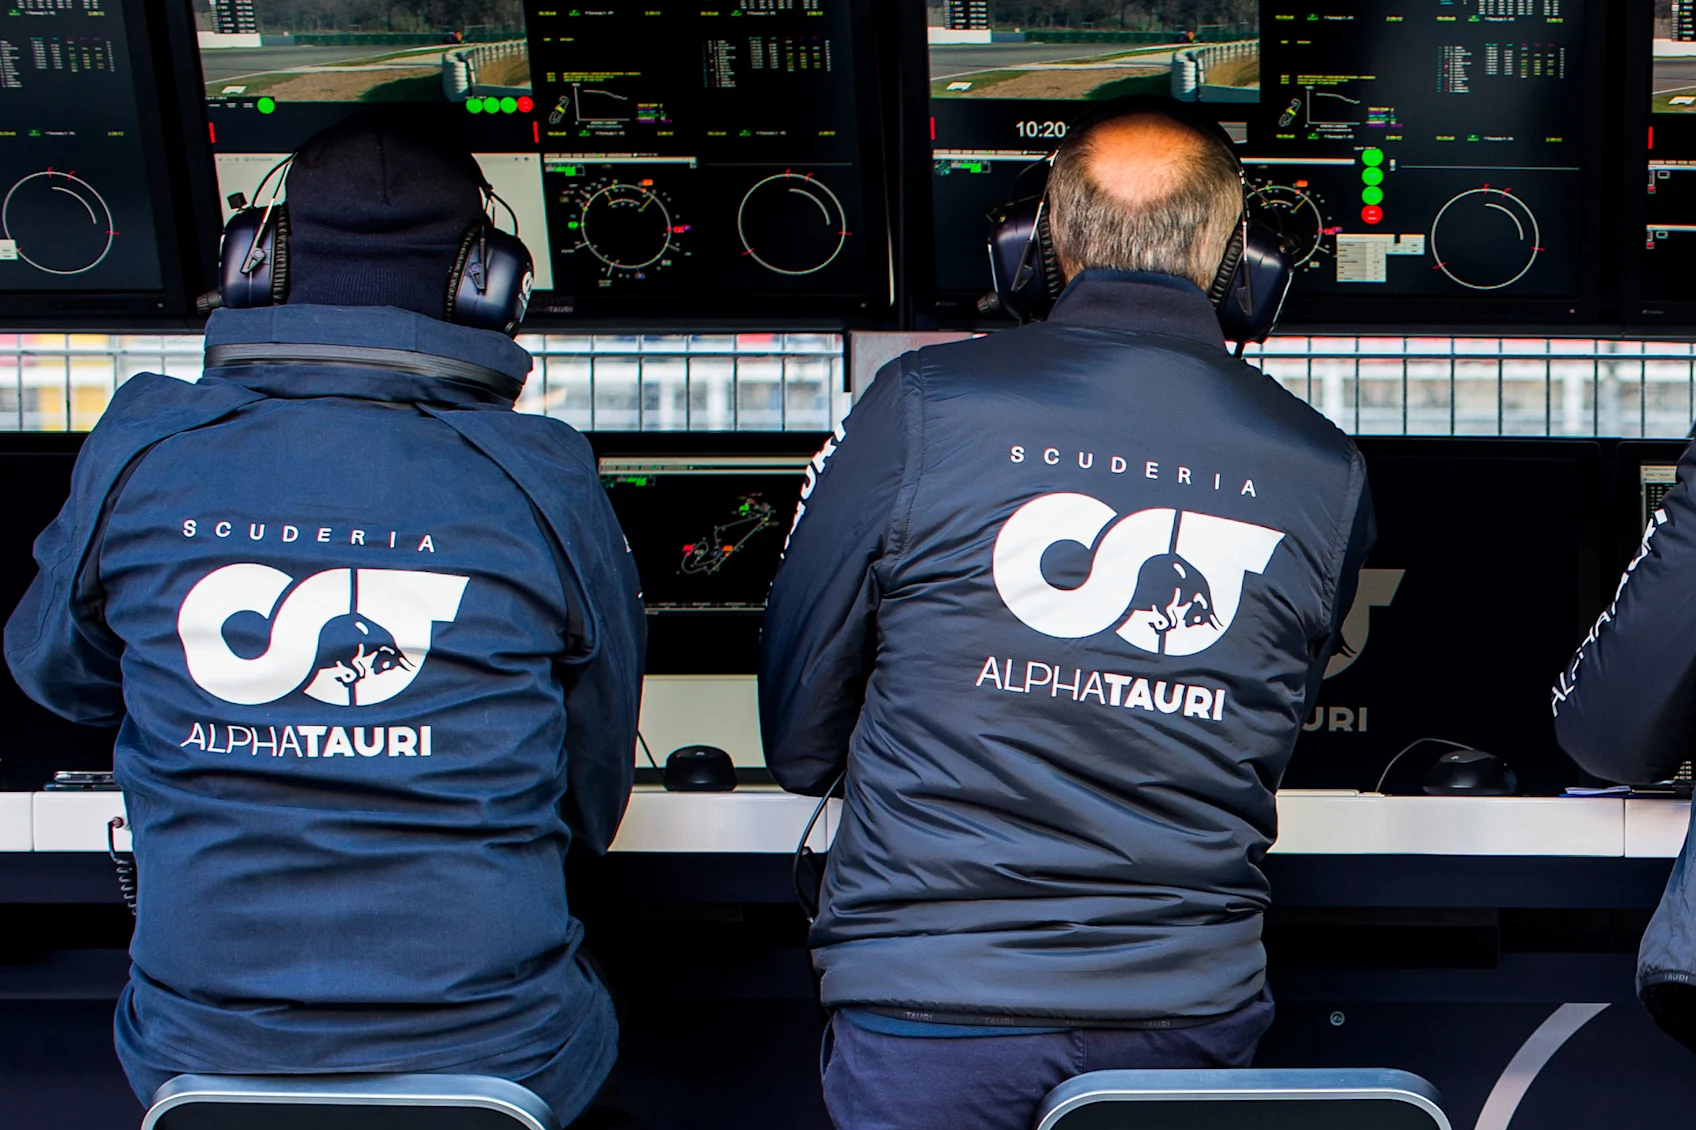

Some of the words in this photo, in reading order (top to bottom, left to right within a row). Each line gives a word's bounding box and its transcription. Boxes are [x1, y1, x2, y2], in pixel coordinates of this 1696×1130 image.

[1010, 446, 1257, 499] SCUDERIA
[183, 519, 434, 553] SCUDERIA
[976, 656, 1226, 721] ALPHATAURI
[181, 721, 432, 758] ALPHATAURI
